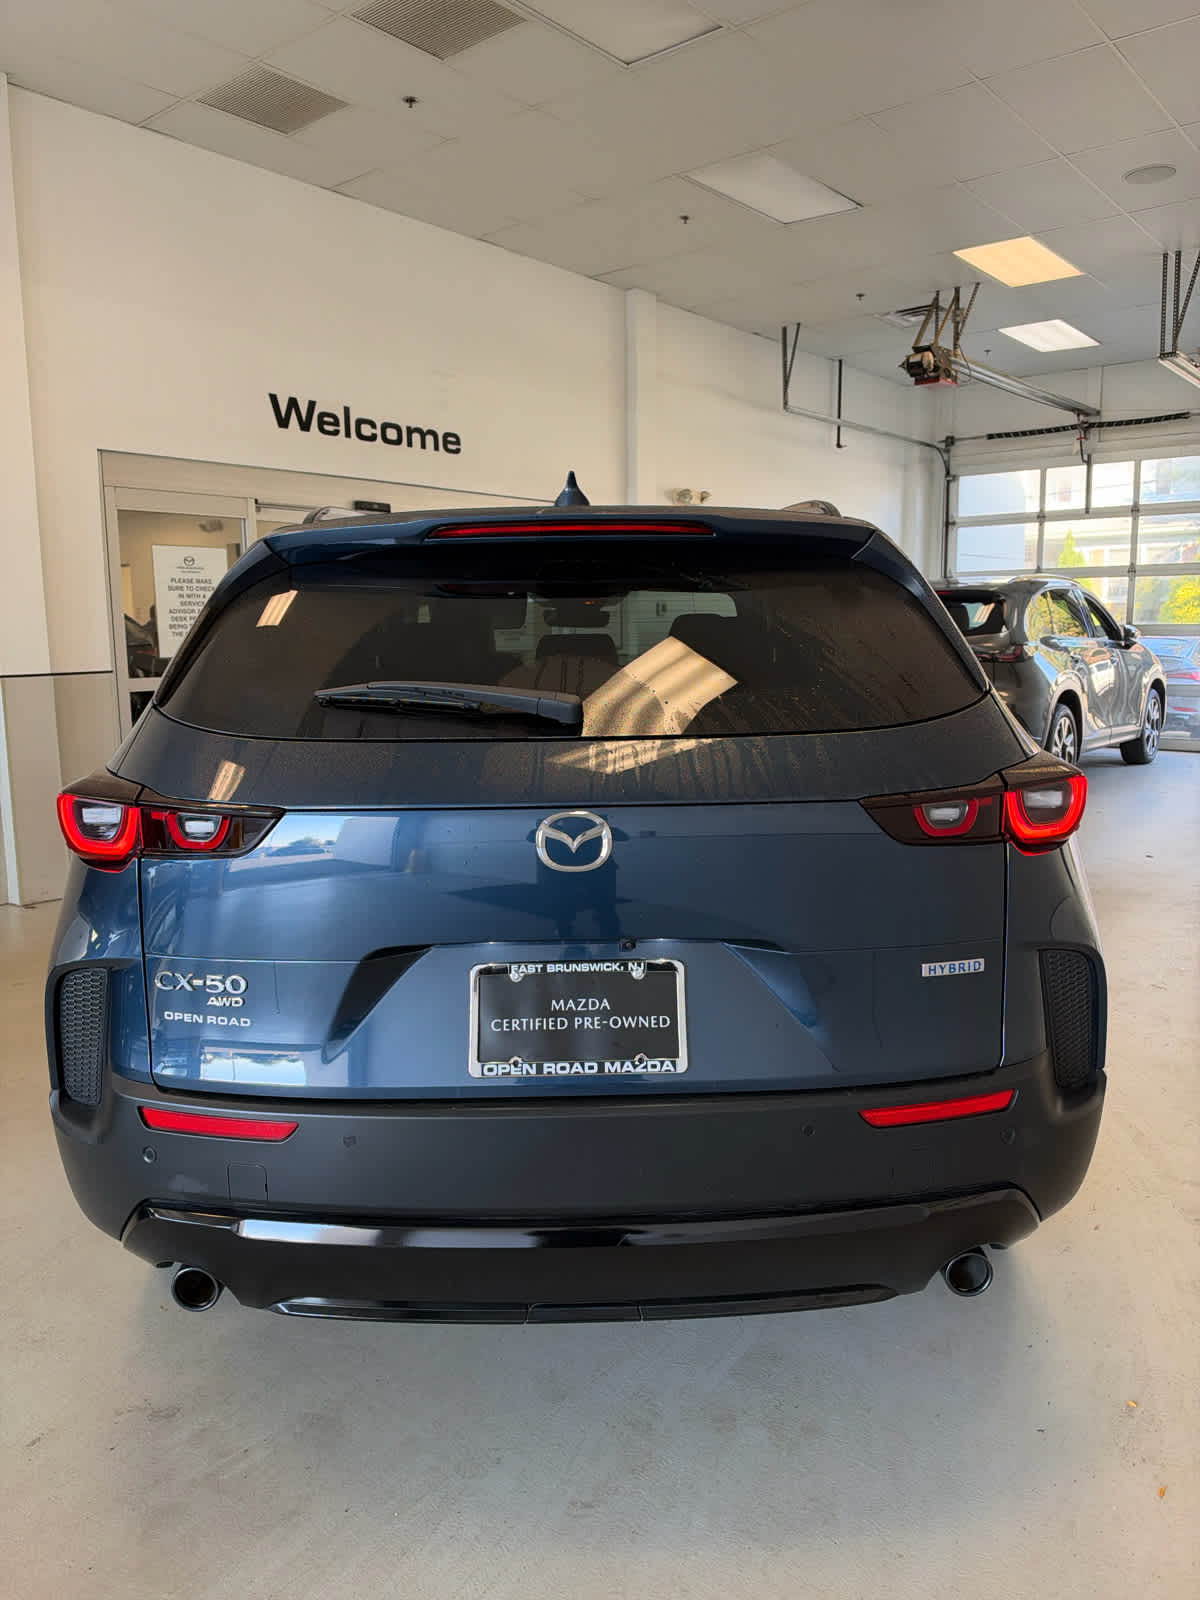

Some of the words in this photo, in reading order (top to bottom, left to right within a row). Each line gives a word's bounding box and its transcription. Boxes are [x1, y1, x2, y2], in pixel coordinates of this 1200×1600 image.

[268, 392, 462, 455] Welcome
[511, 964, 543, 973] EAST
[547, 962, 624, 973] BRUNSWICK,
[928, 960, 982, 975] HYBRID
[154, 971, 247, 994] CX-50
[207, 996, 243, 1007] AWD
[551, 998, 611, 1011] MAZDA
[164, 1011, 203, 1024] OPEN
[206, 1015, 251, 1027] ROAD
[491, 1017, 568, 1032] CERTIFIED
[574, 1015, 671, 1030] PRE-OWNED
[483, 1062, 536, 1076] OPEN
[543, 1062, 598, 1074] ROAD
[604, 1060, 675, 1073] MAZDA
